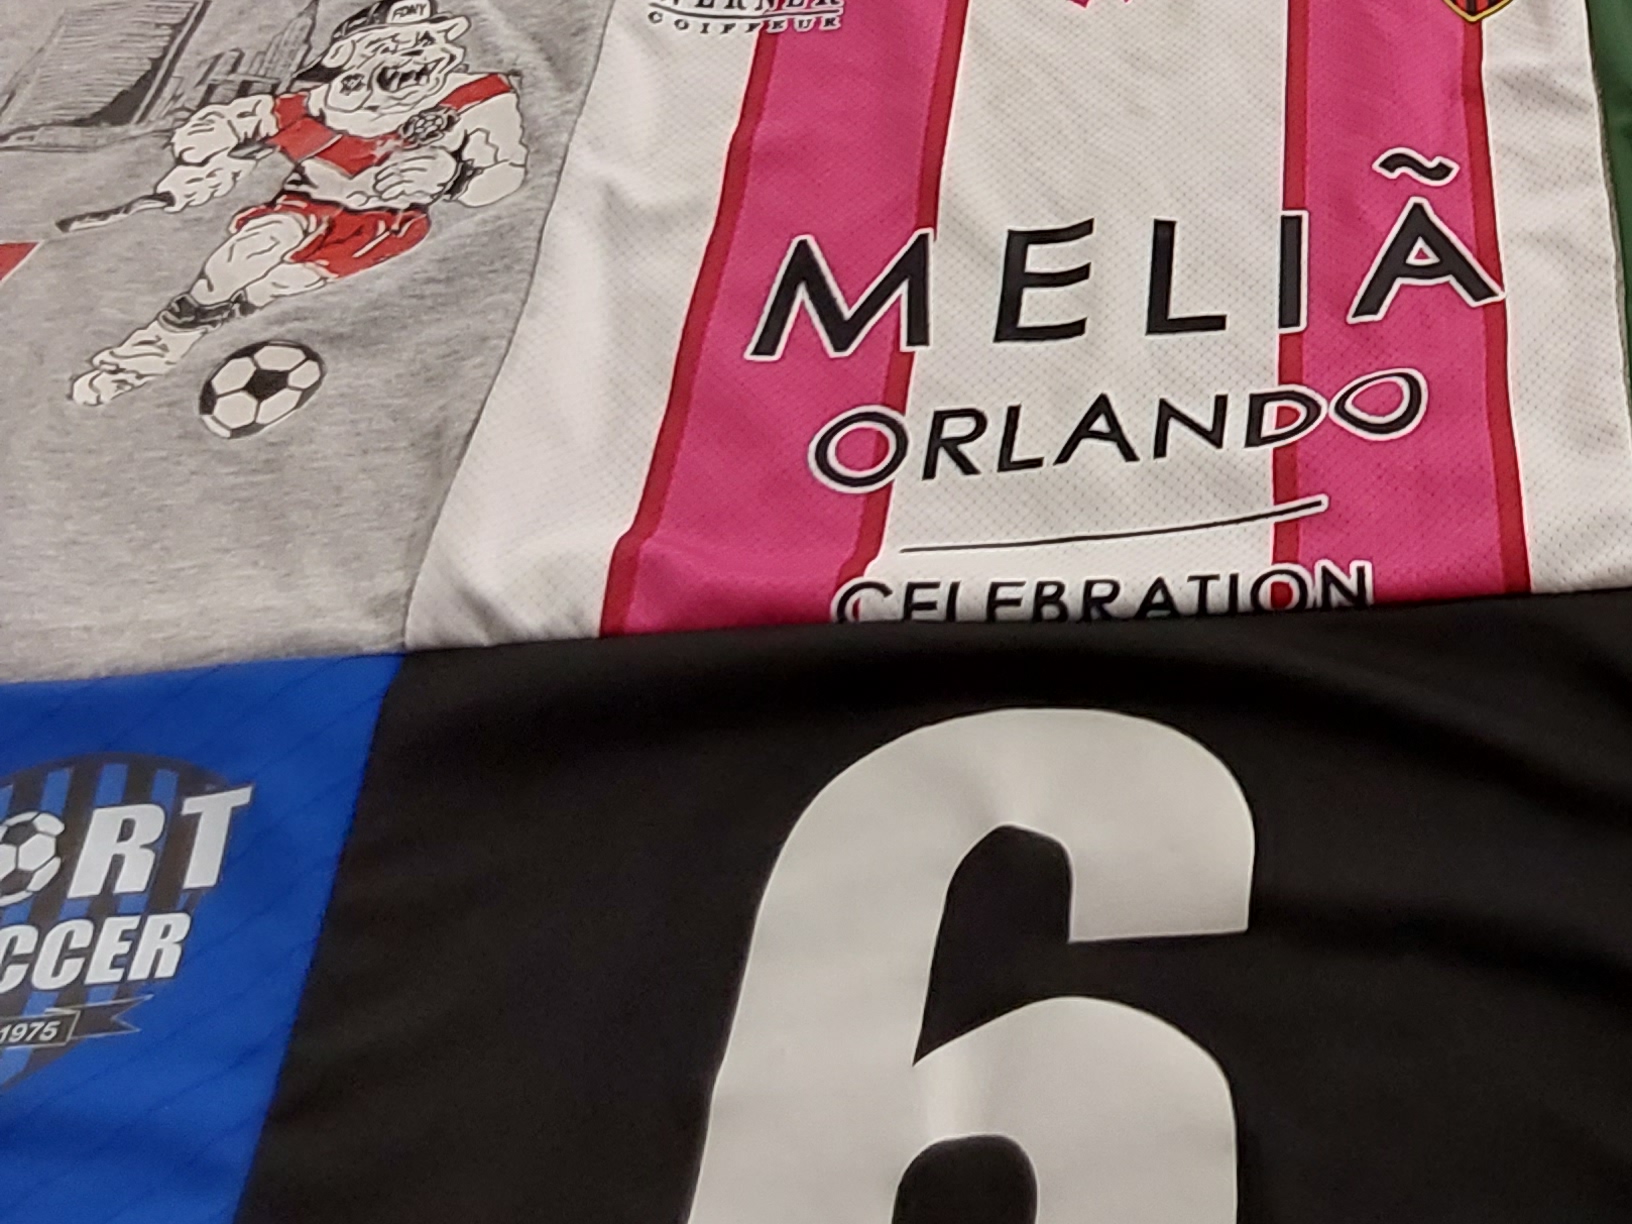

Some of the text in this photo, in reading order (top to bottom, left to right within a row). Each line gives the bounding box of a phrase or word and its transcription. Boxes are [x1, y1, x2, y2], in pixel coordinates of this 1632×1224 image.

[648, 10, 843, 35] COIFFEUR
[810, 369, 1426, 493] ORLANDO
[0, 1020, 61, 1044] 1975
